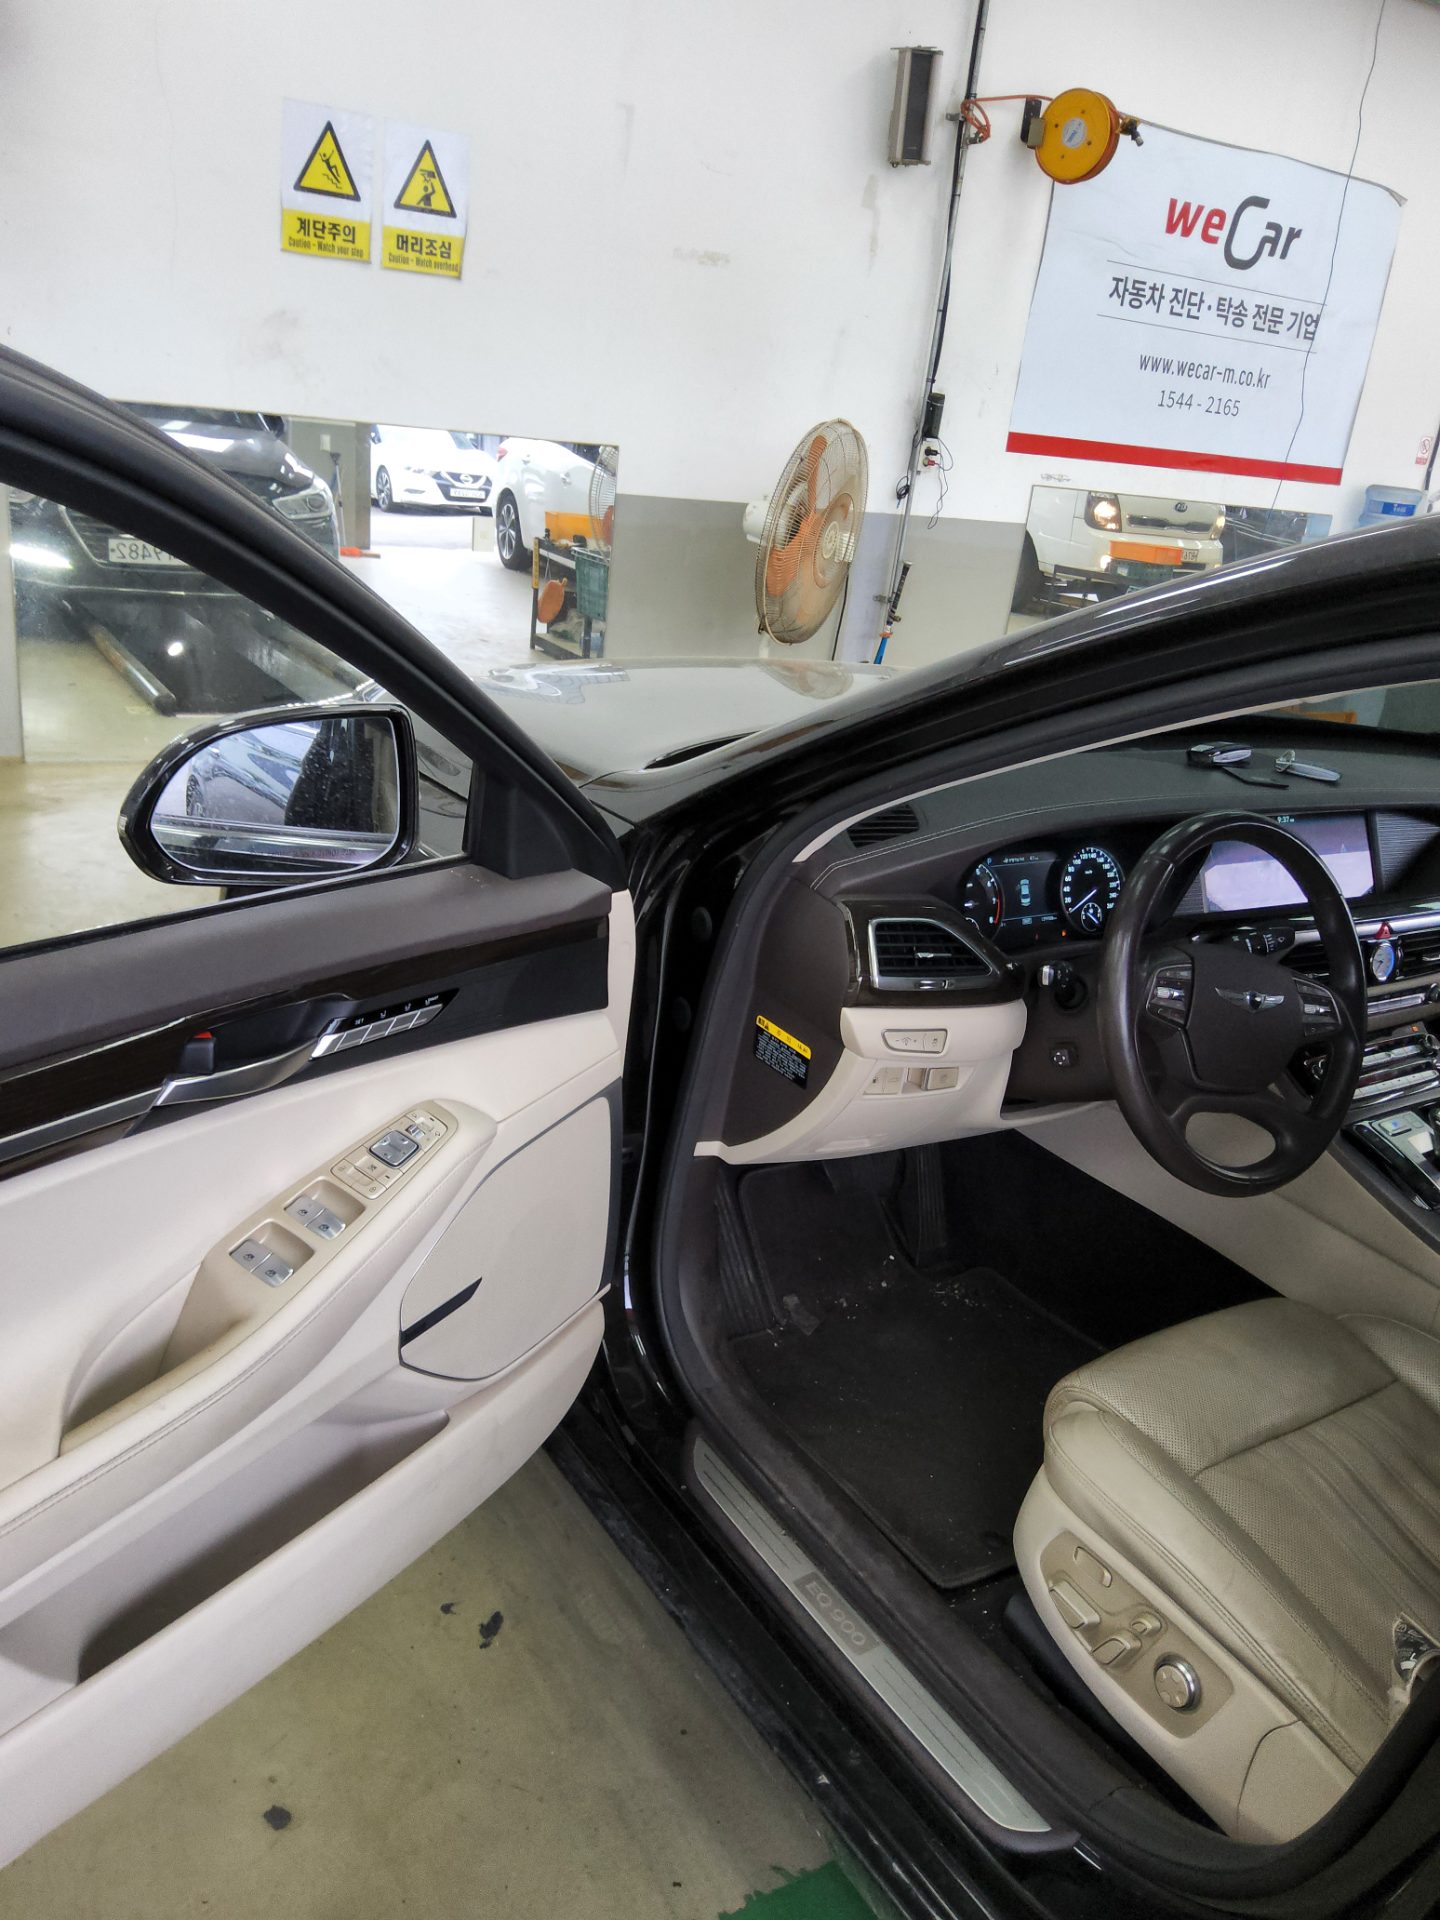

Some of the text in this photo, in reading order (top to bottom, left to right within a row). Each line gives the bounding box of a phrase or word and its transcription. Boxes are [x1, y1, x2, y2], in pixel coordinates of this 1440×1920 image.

[296, 216, 356, 245] 계단주의
[1165, 195, 1303, 271] weCar
[288, 236, 311, 250] Caution
[317, 240, 336, 253] Watch
[336, 245, 350, 256] your
[396, 233, 452, 260] 머리조심
[388, 252, 410, 266] Caution
[415, 256, 433, 269] Watch
[433, 259, 459, 273] overhead
[1108, 275, 1165, 314] 자동차
[1252, 302, 1285, 335] 전문
[1286, 310, 1320, 342] 기업
[1138, 353, 1272, 390] www.wecar-m.co.kr
